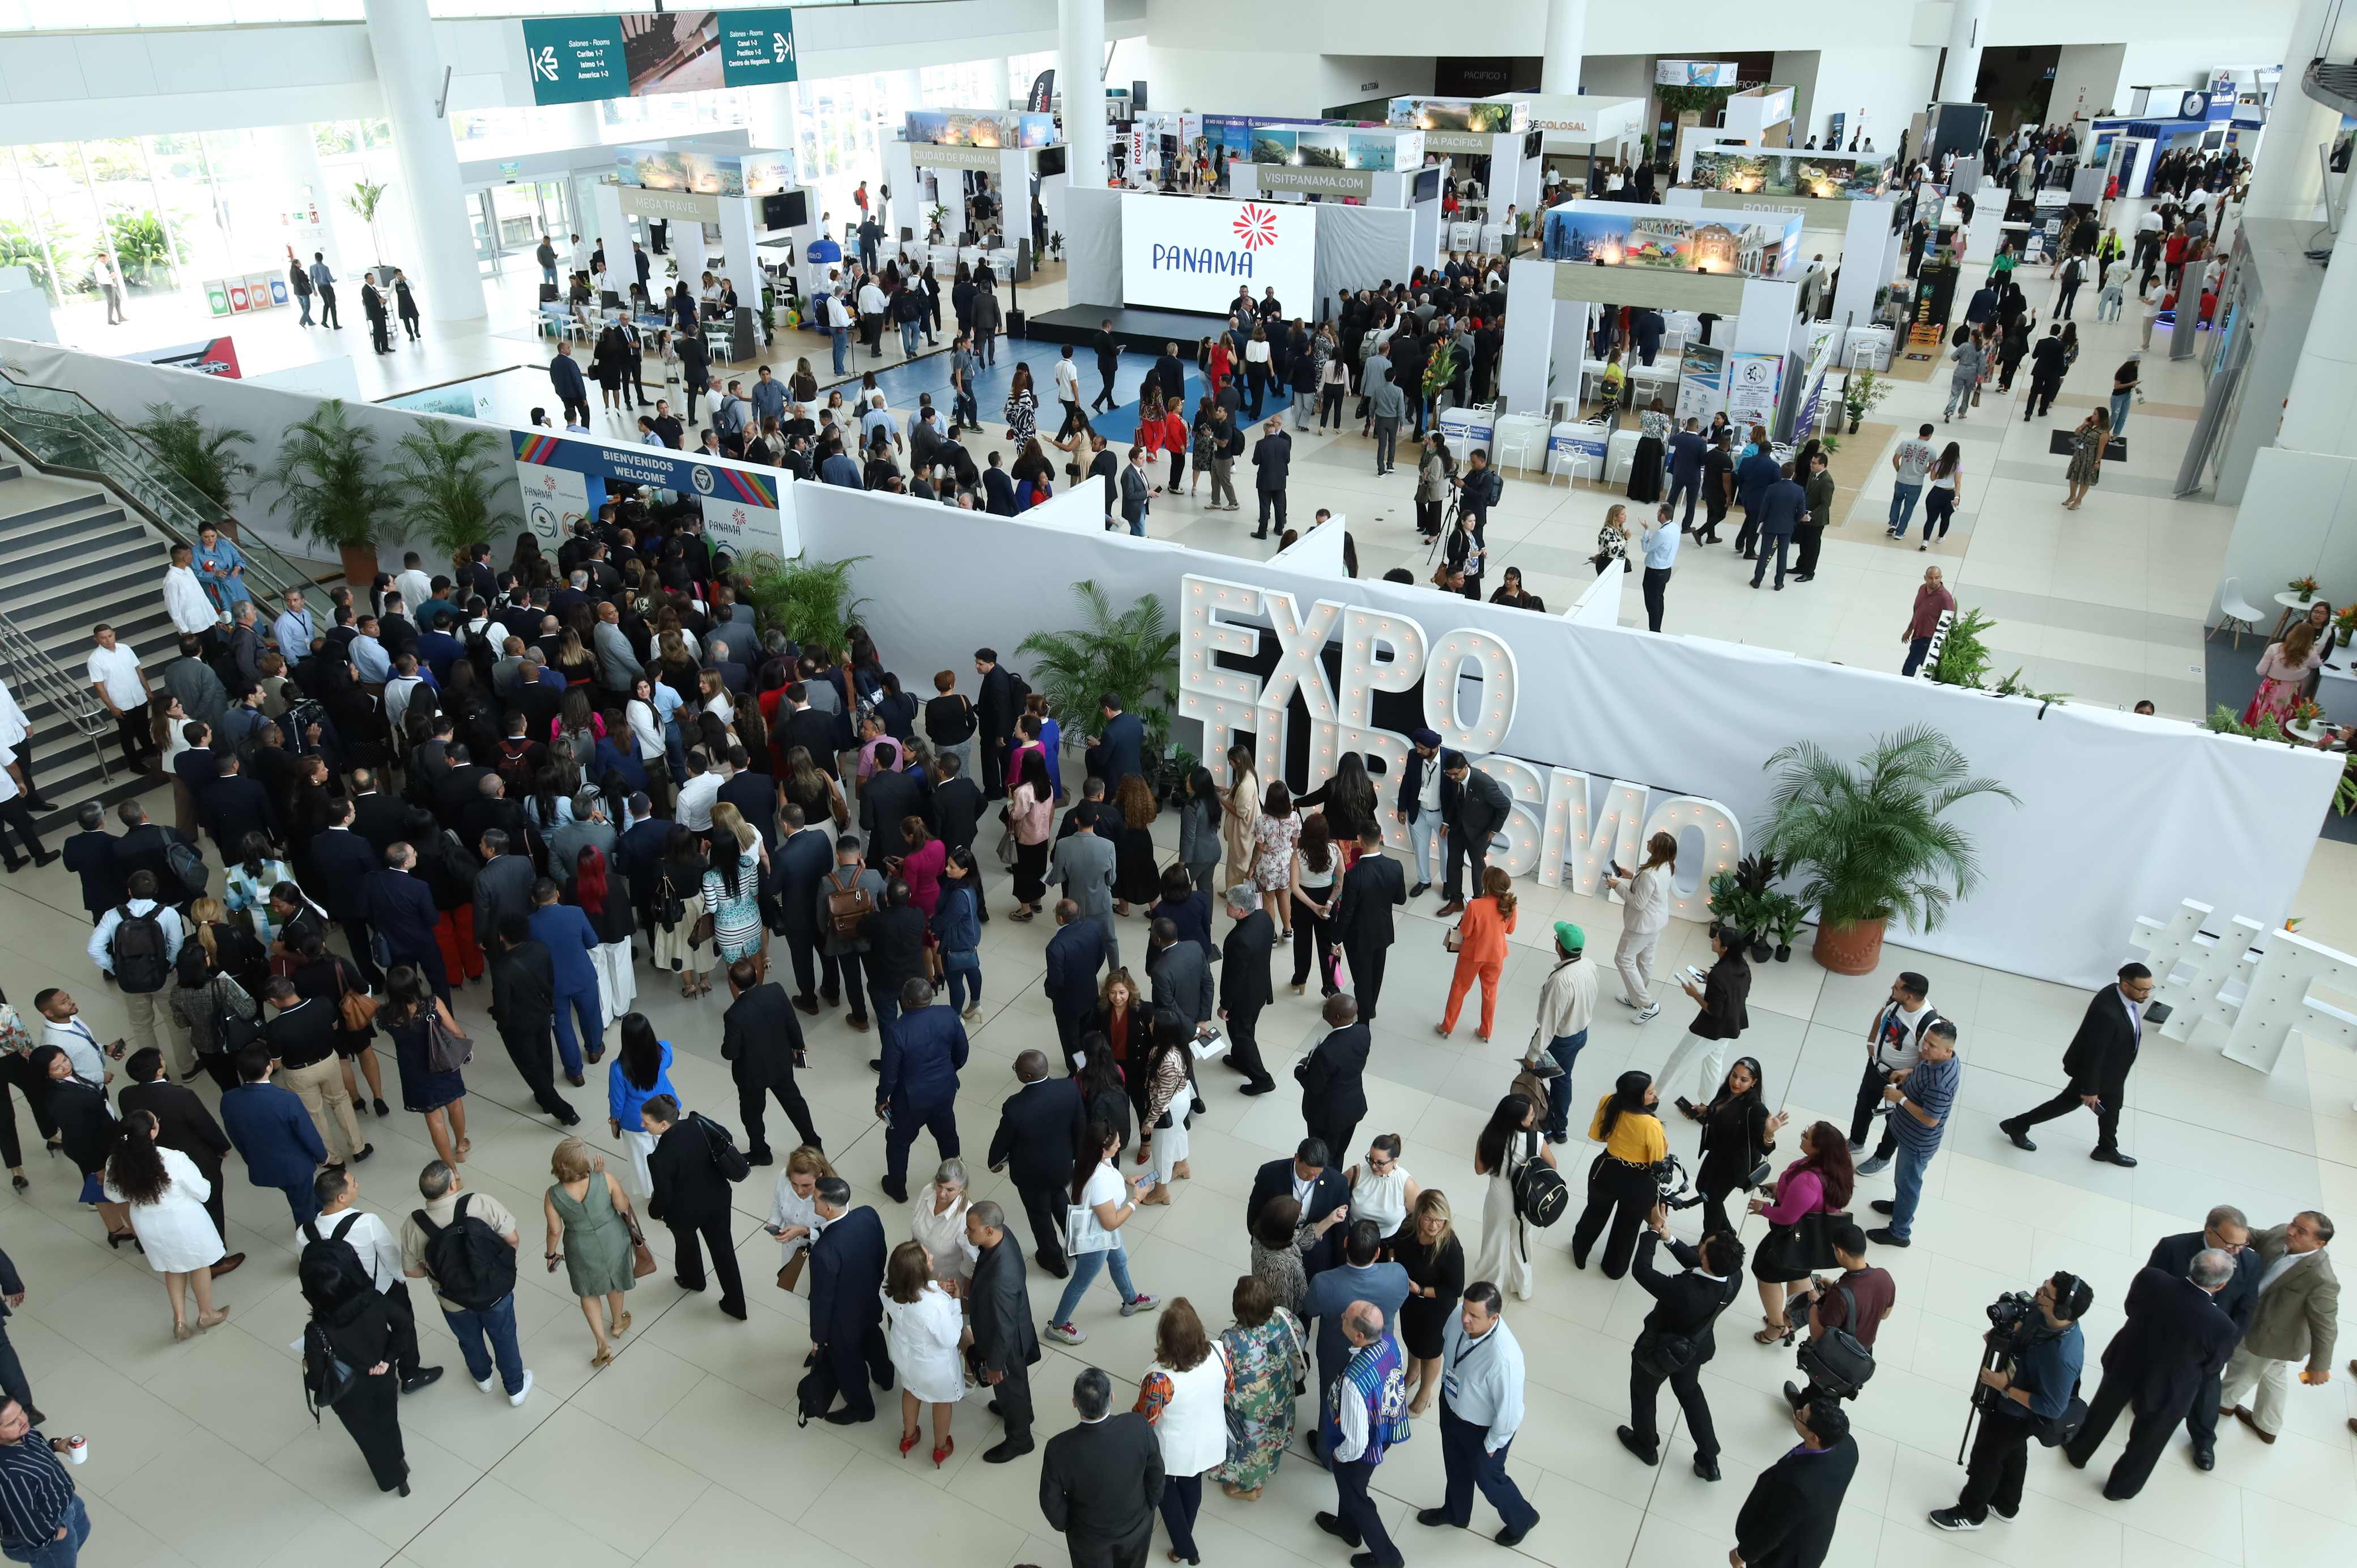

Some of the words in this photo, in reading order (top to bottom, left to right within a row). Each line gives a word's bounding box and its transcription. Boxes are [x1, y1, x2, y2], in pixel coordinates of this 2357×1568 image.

[750, 58, 770, 66] Negocios
[1361, 80, 1379, 92] BOLETERÍA
[1440, 135, 1483, 148] PACÍFICA
[913, 151, 945, 162] CIUDAD
[947, 153, 958, 163] DE
[959, 154, 997, 165] PANAMÁ
[1264, 172, 1364, 190] VISITPANAMA.COM
[636, 197, 662, 210] MEGA
[663, 200, 700, 215] TRAVEL
[1152, 243, 1253, 279] PANAMA
[602, 450, 674, 472] BIENVENIDOS
[614, 466, 667, 484] WELCOME
[524, 486, 552, 501] PANAMA
[709, 519, 741, 536] PANAMA
[748, 527, 778, 536] VisitPanama.com
[1180, 573, 1519, 754] EXPO
